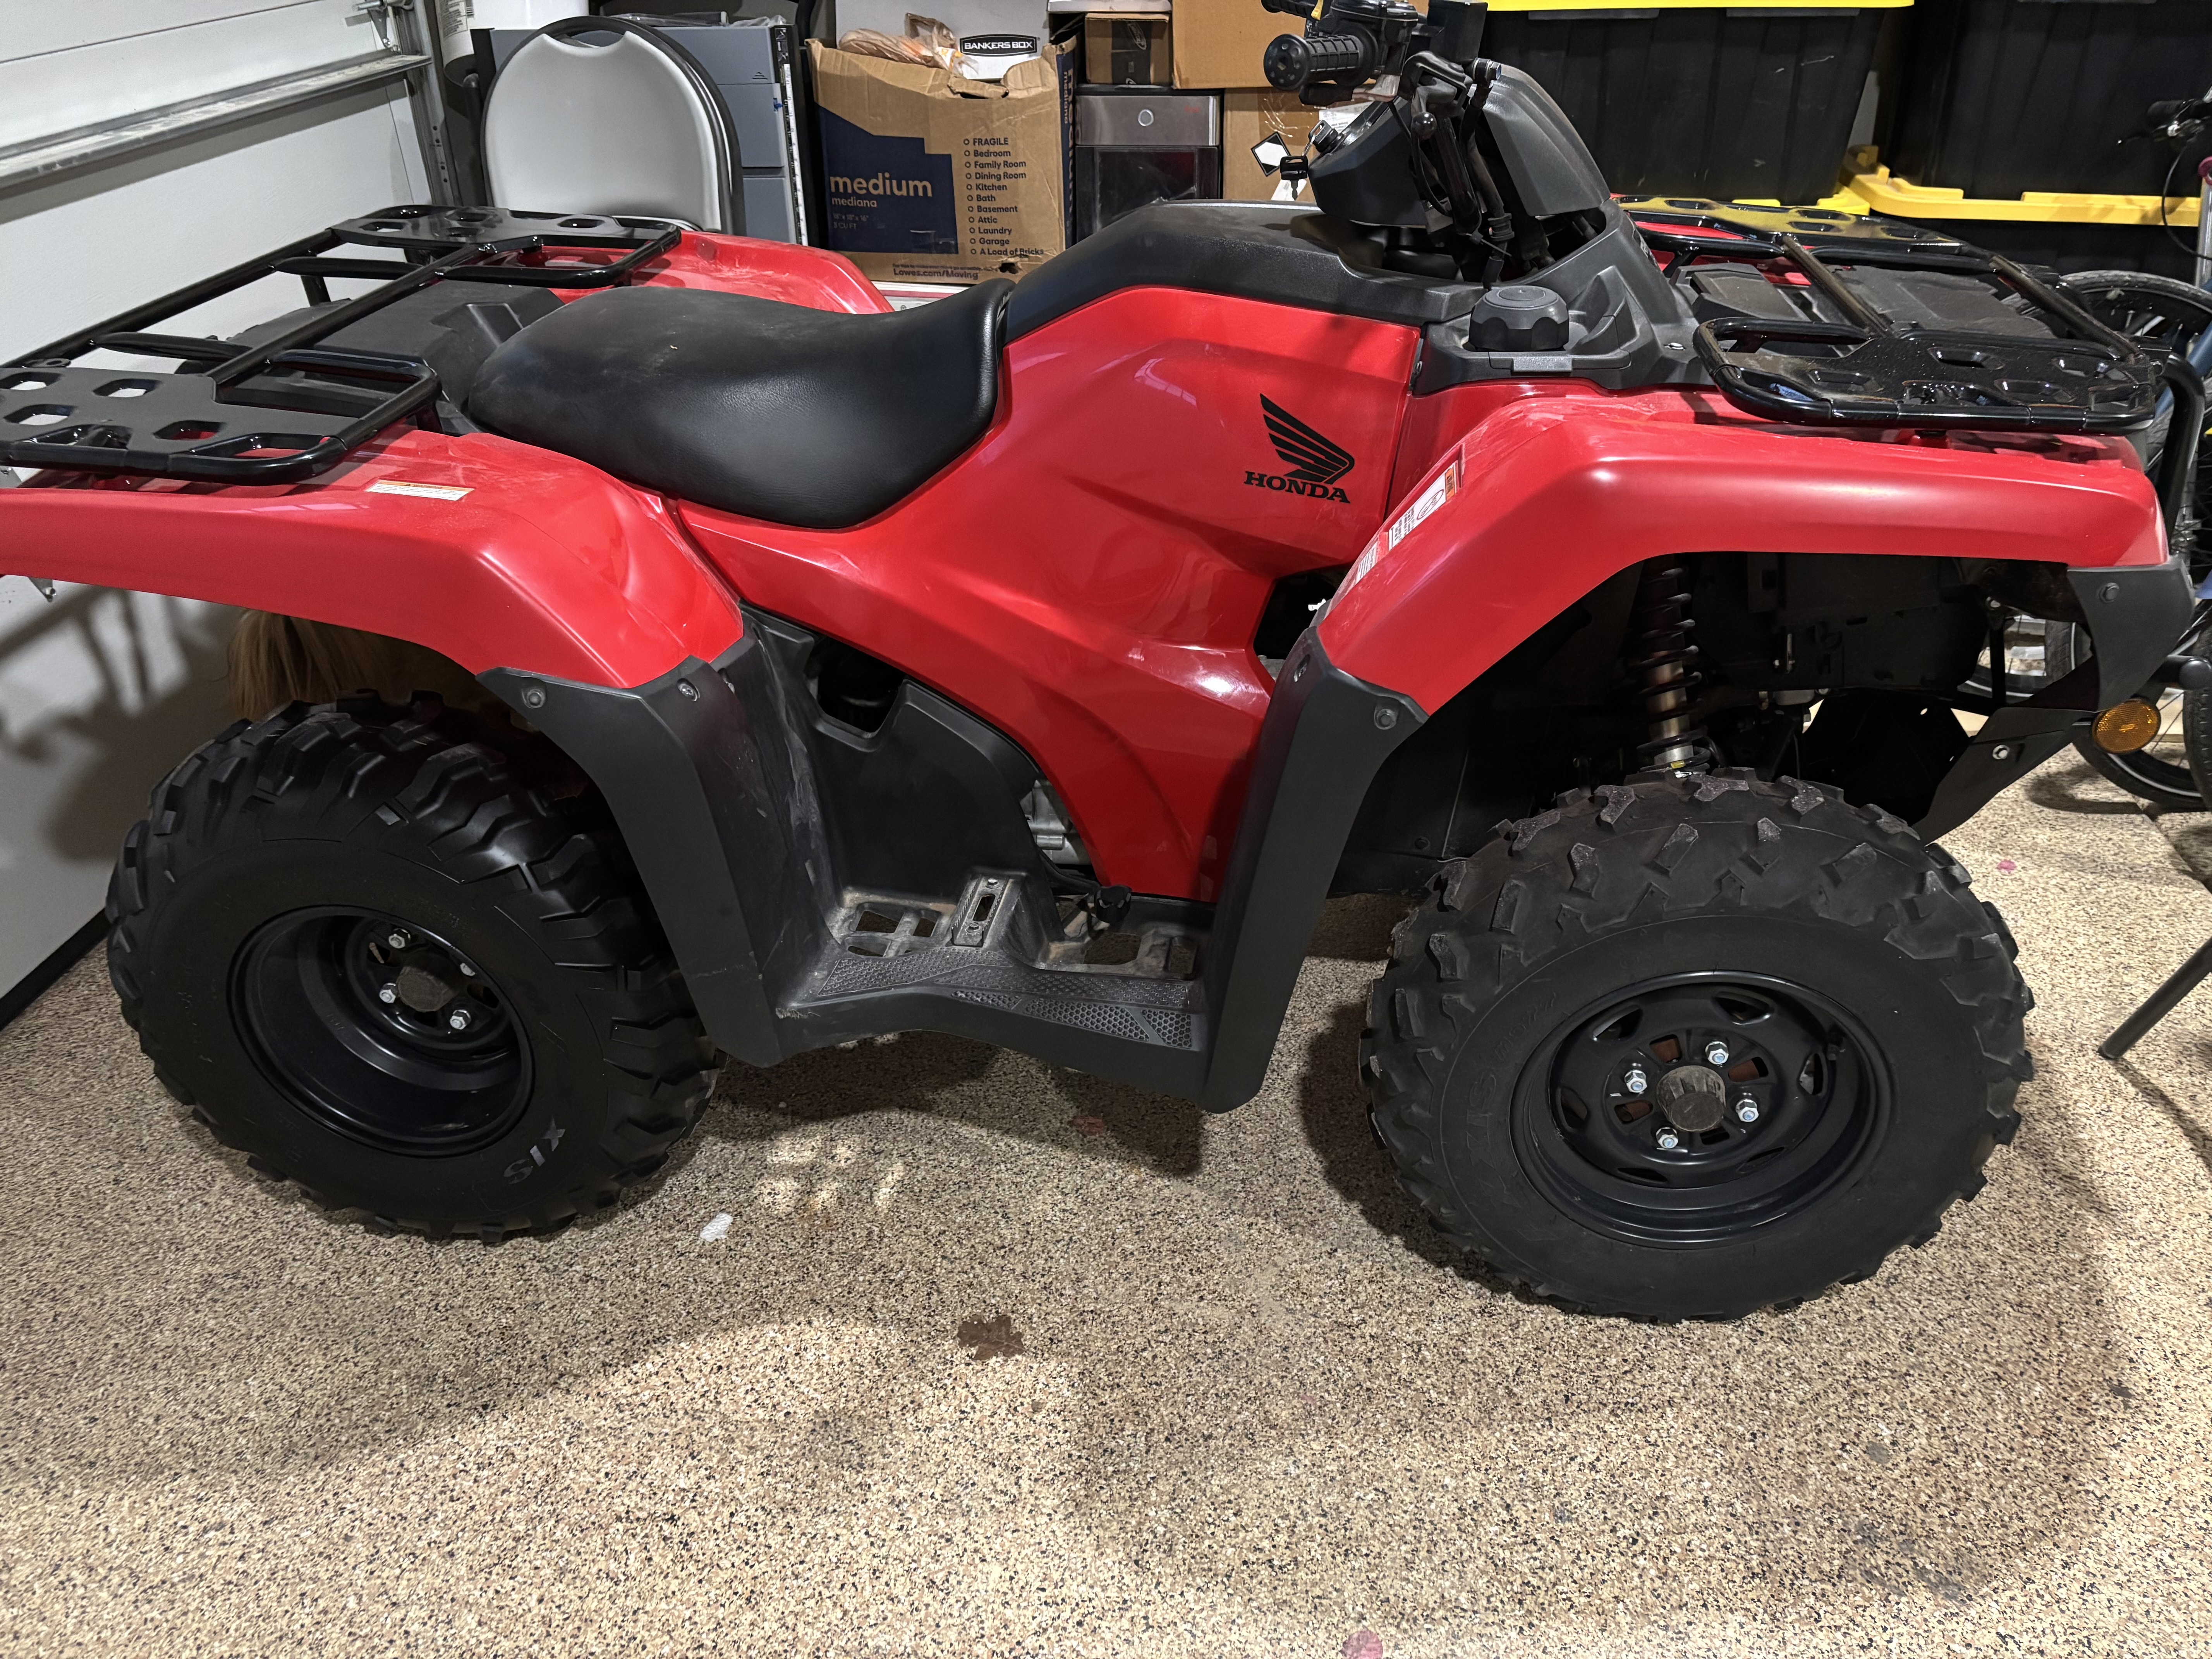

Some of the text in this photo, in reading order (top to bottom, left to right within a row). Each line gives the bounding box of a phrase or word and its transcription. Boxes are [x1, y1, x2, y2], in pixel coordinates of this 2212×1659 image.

[964, 41, 1011, 50] BANKERS
[973, 137, 1009, 146] FRAGILE
[974, 161, 1001, 169] Family
[975, 172, 1001, 181] Dining
[830, 172, 933, 197] medium
[832, 196, 878, 208] mediana
[978, 227, 1012, 235] Laundry
[979, 237, 1010, 246] Garage
[893, 268, 979, 280] Lowes.com/Moving
[1243, 470, 1351, 504] HONDA
